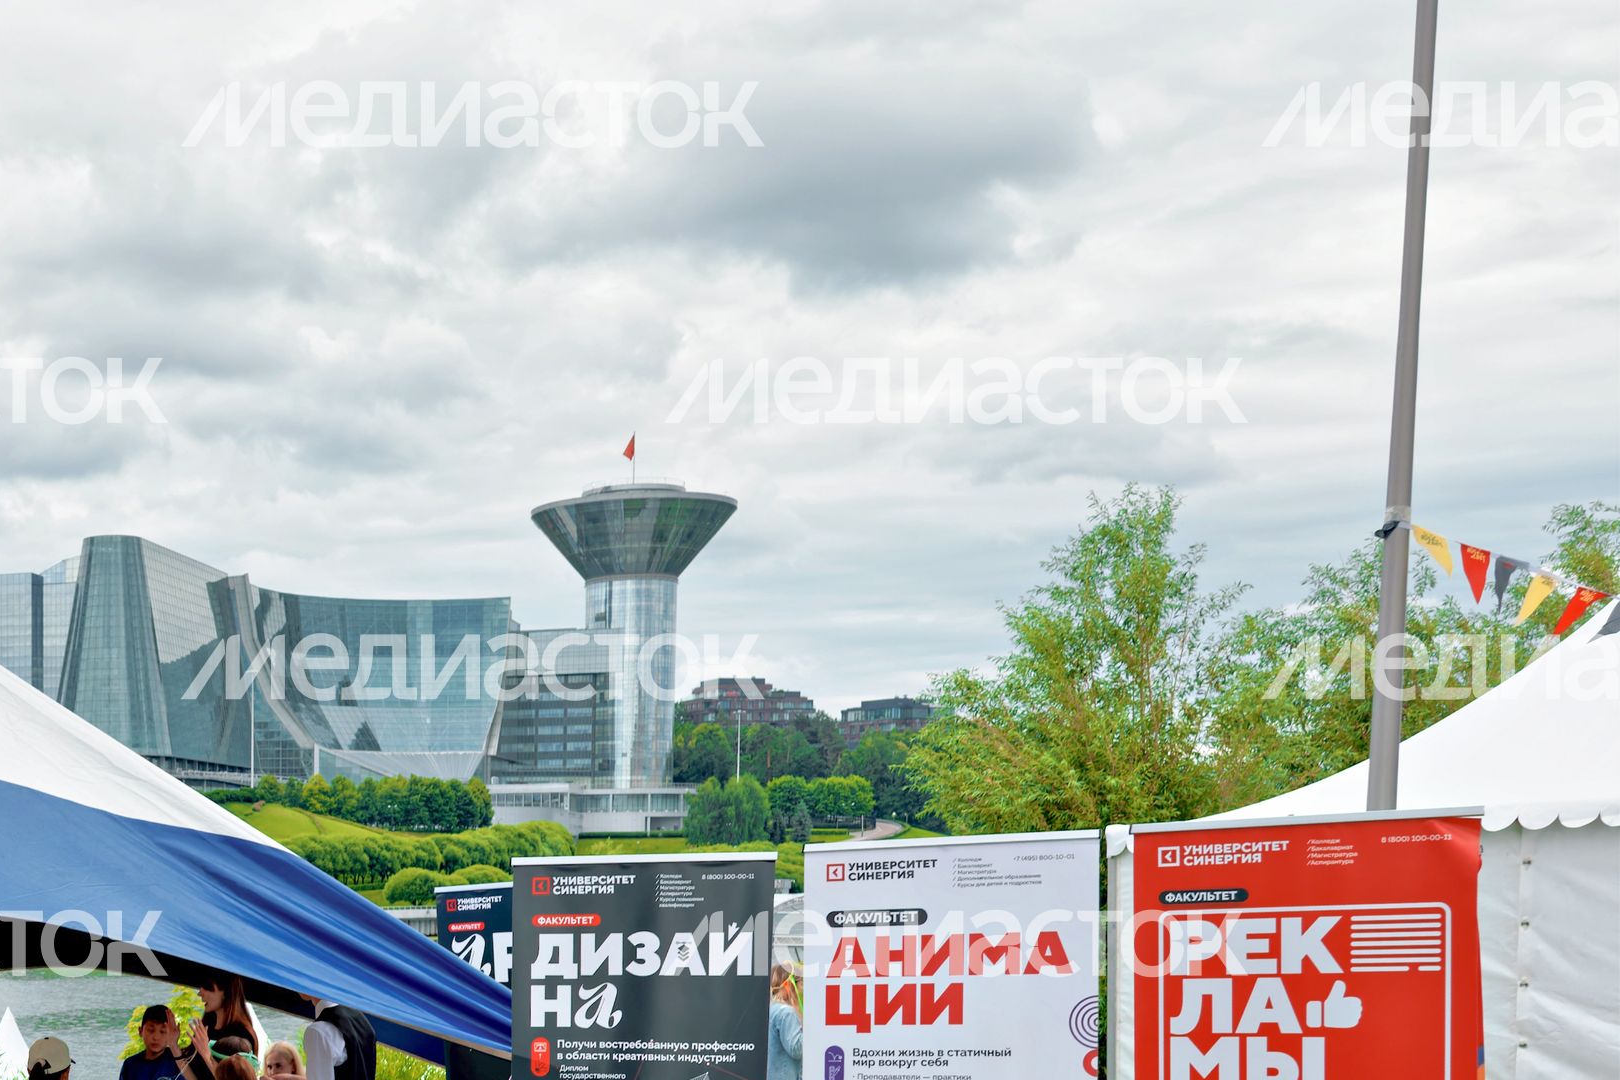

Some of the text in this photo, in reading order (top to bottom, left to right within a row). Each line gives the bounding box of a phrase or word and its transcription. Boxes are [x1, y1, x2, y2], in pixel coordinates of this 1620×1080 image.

[1183, 841, 1289, 856] УНИВЕРСИТЕТ
[849, 859, 938, 871] УНИВЕРСИТЕТ
[1183, 853, 1262, 866] СИНЕРГИЯ
[553, 875, 636, 886] УНИВЕРСИТЕТ
[848, 869, 915, 881] СИНЕРГИЯ
[553, 884, 614, 895] СИНЕРГИЯ
[457, 895, 502, 906] УНИВЕРСИТЕТ
[1165, 890, 1237, 903] ФАКУЛЬТЕТ
[457, 902, 492, 911] СИНЕРГИЯ
[537, 915, 594, 926] ФАКУЛЬТЕТ
[834, 911, 919, 924] ФАКУЛЬТЕТ
[531, 922, 753, 979] ДИЗАЙ
[1170, 916, 1344, 976] РЕК
[826, 931, 1074, 978] АНИМА
[825, 982, 964, 1033] ЦИИ
[1170, 977, 1302, 1035] ЛА
[557, 1039, 755, 1053] Получи востребованную профессию
[563, 1052, 610, 1060] области
[612, 1053, 675, 1063] креативных
[678, 1052, 736, 1064] индустрий
[852, 1048, 895, 1059] Вдохни
[898, 1049, 934, 1057] жизнь
[947, 1047, 1012, 1057] статичный
[559, 1065, 589, 1073] Диплом
[852, 1057, 949, 1070] мир вокруг себя
[559, 1073, 626, 1080] государственного
